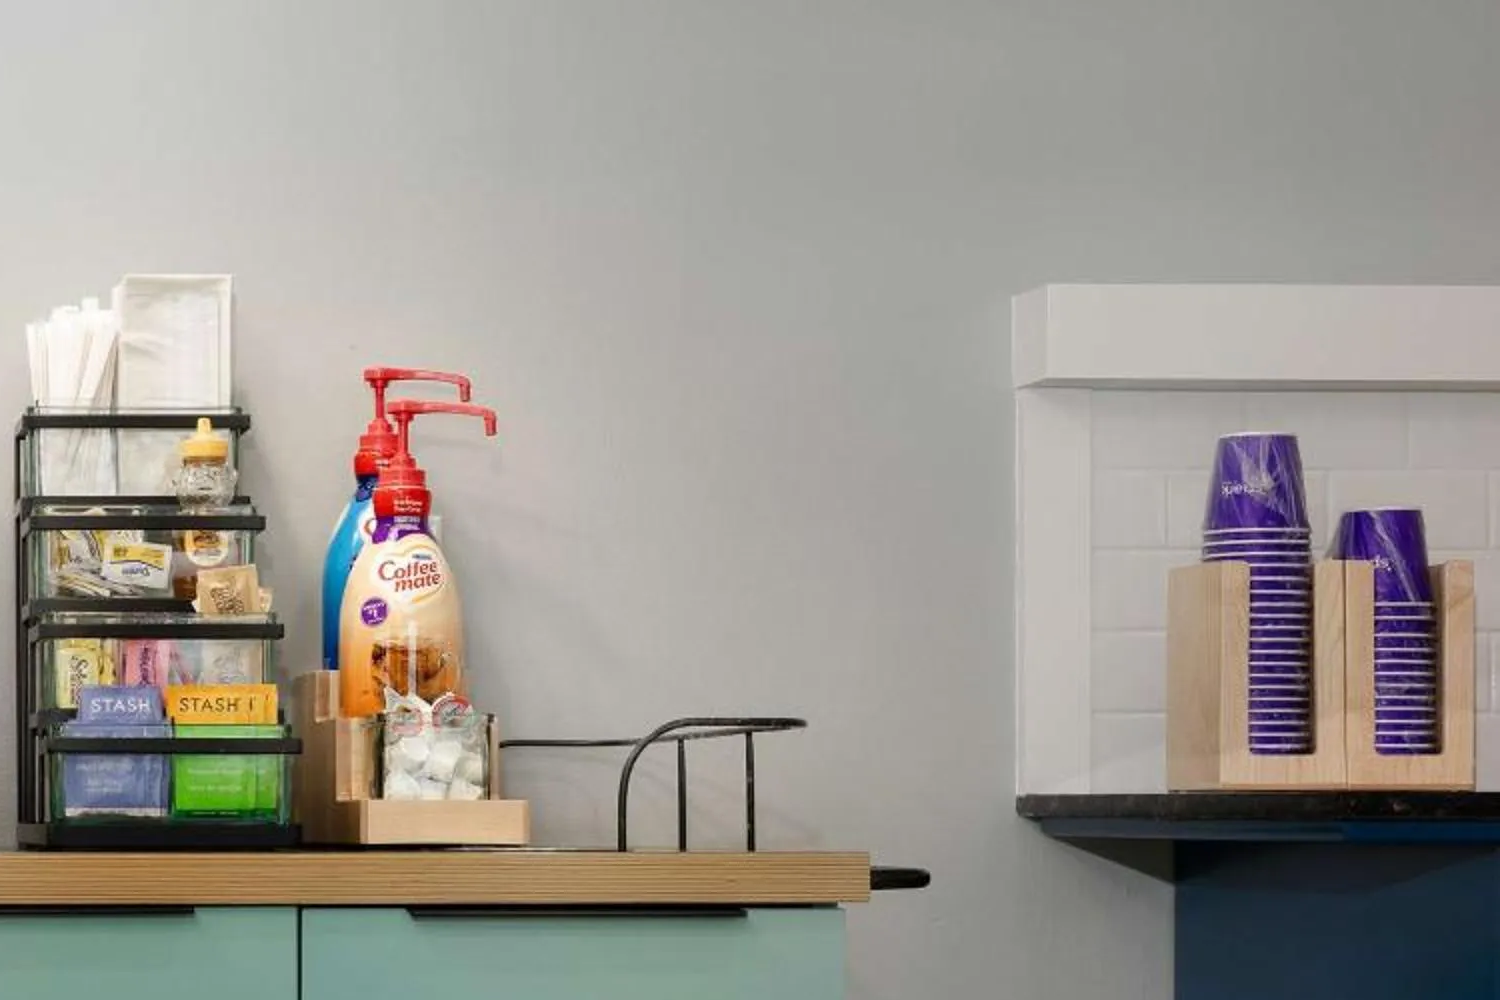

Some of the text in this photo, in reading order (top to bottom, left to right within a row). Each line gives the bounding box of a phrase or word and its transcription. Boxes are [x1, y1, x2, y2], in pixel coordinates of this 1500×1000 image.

[378, 560, 438, 581] Coffee
[394, 572, 442, 592] mate
[90, 698, 151, 714] STASH
[179, 697, 239, 713] STASH
